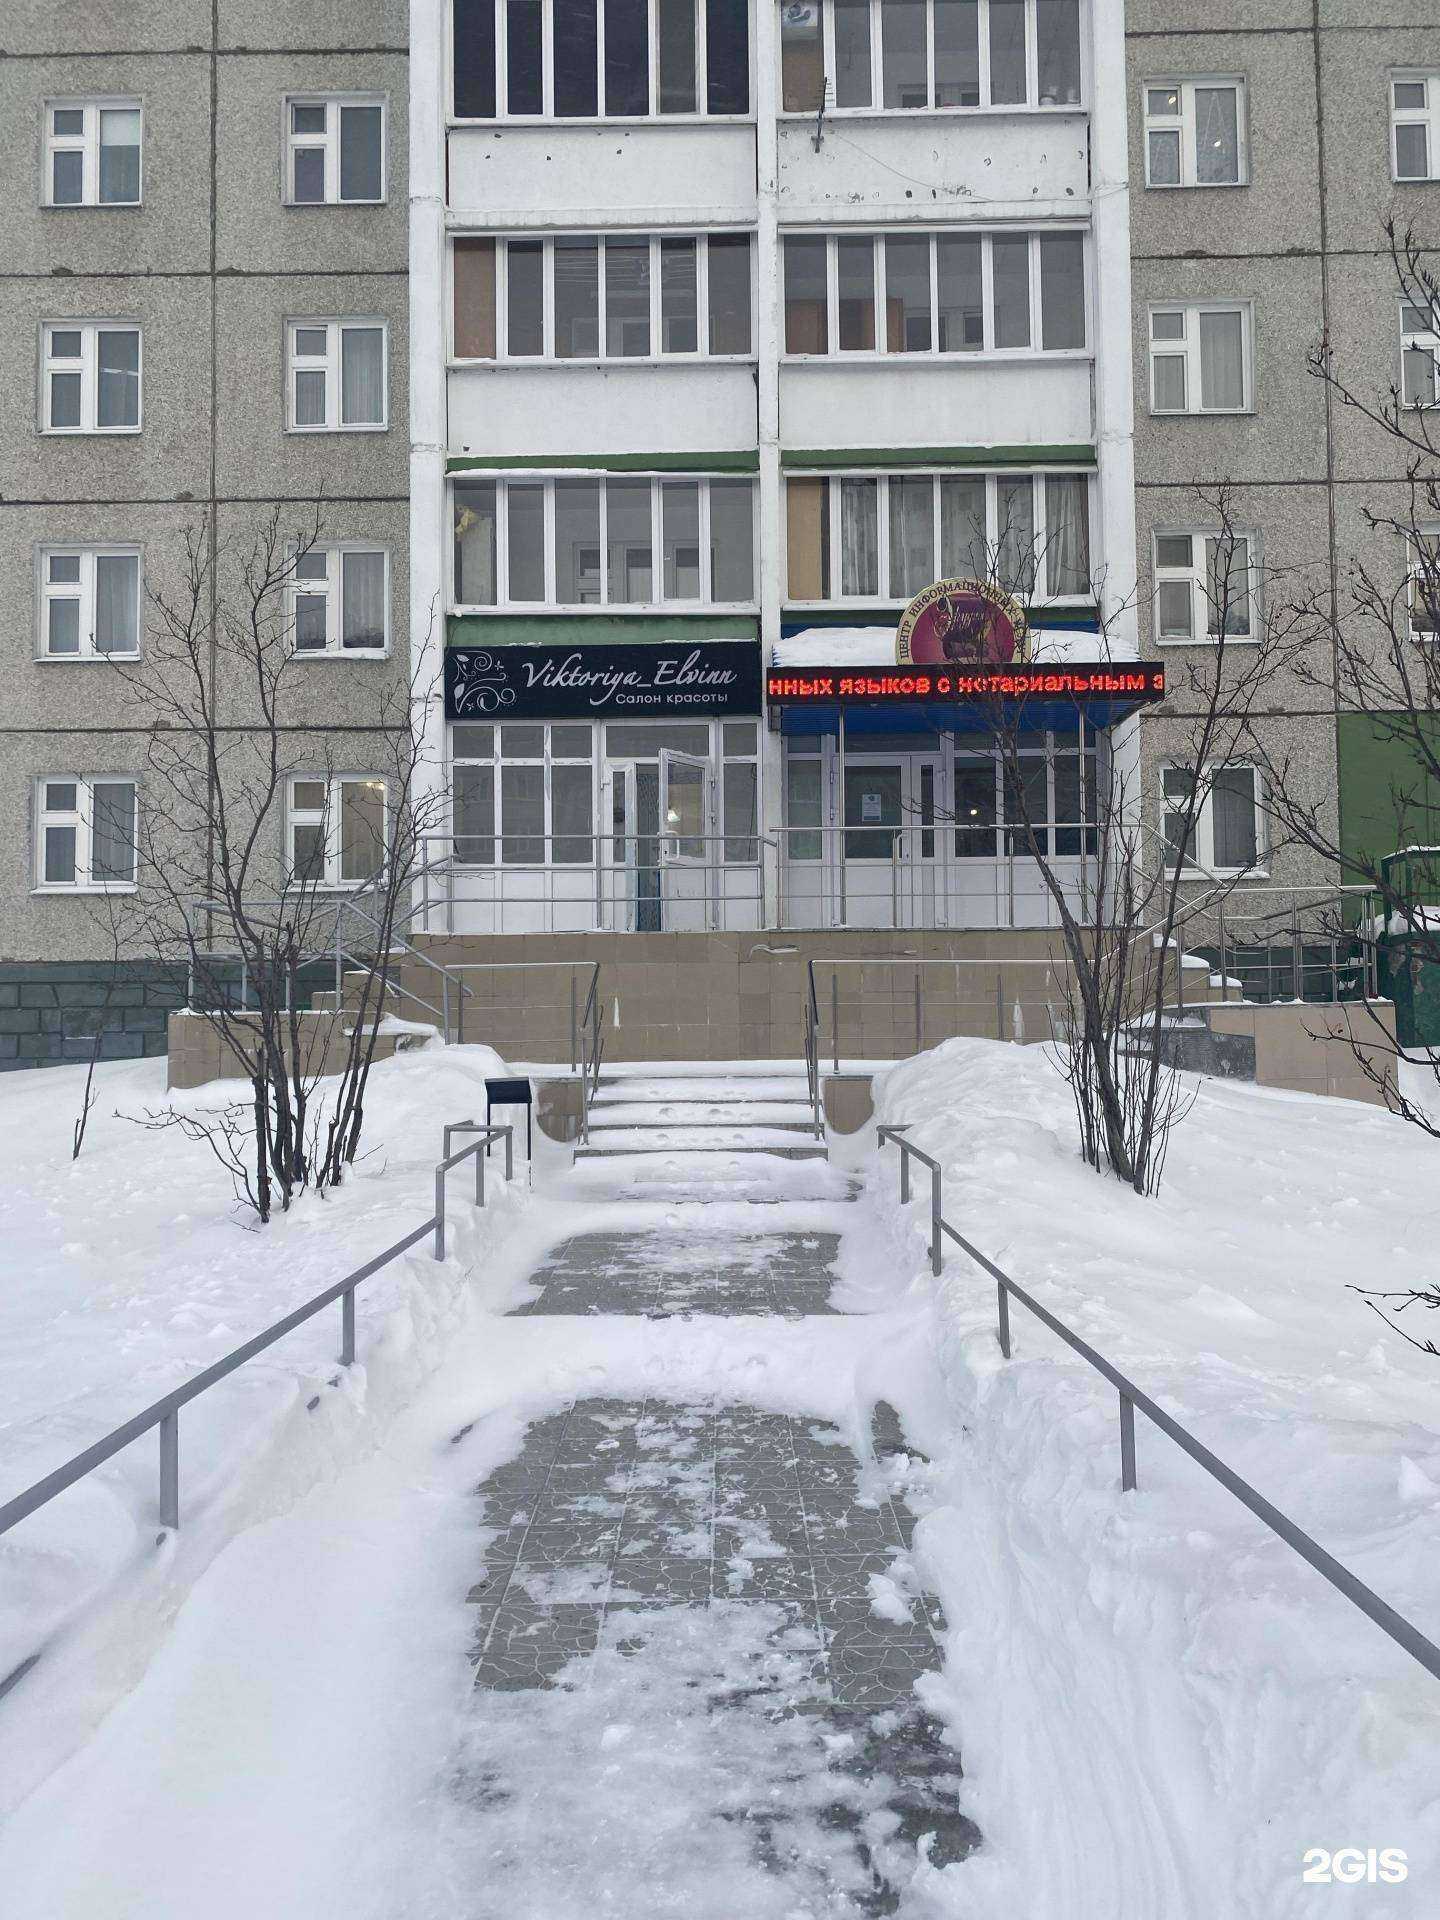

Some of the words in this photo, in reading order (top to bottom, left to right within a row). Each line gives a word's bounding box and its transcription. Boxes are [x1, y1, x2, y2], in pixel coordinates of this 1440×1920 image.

[899, 620, 912, 659] ЦЕНТР
[615, 694, 661, 704] Салон
[666, 693, 728, 704] красоты
